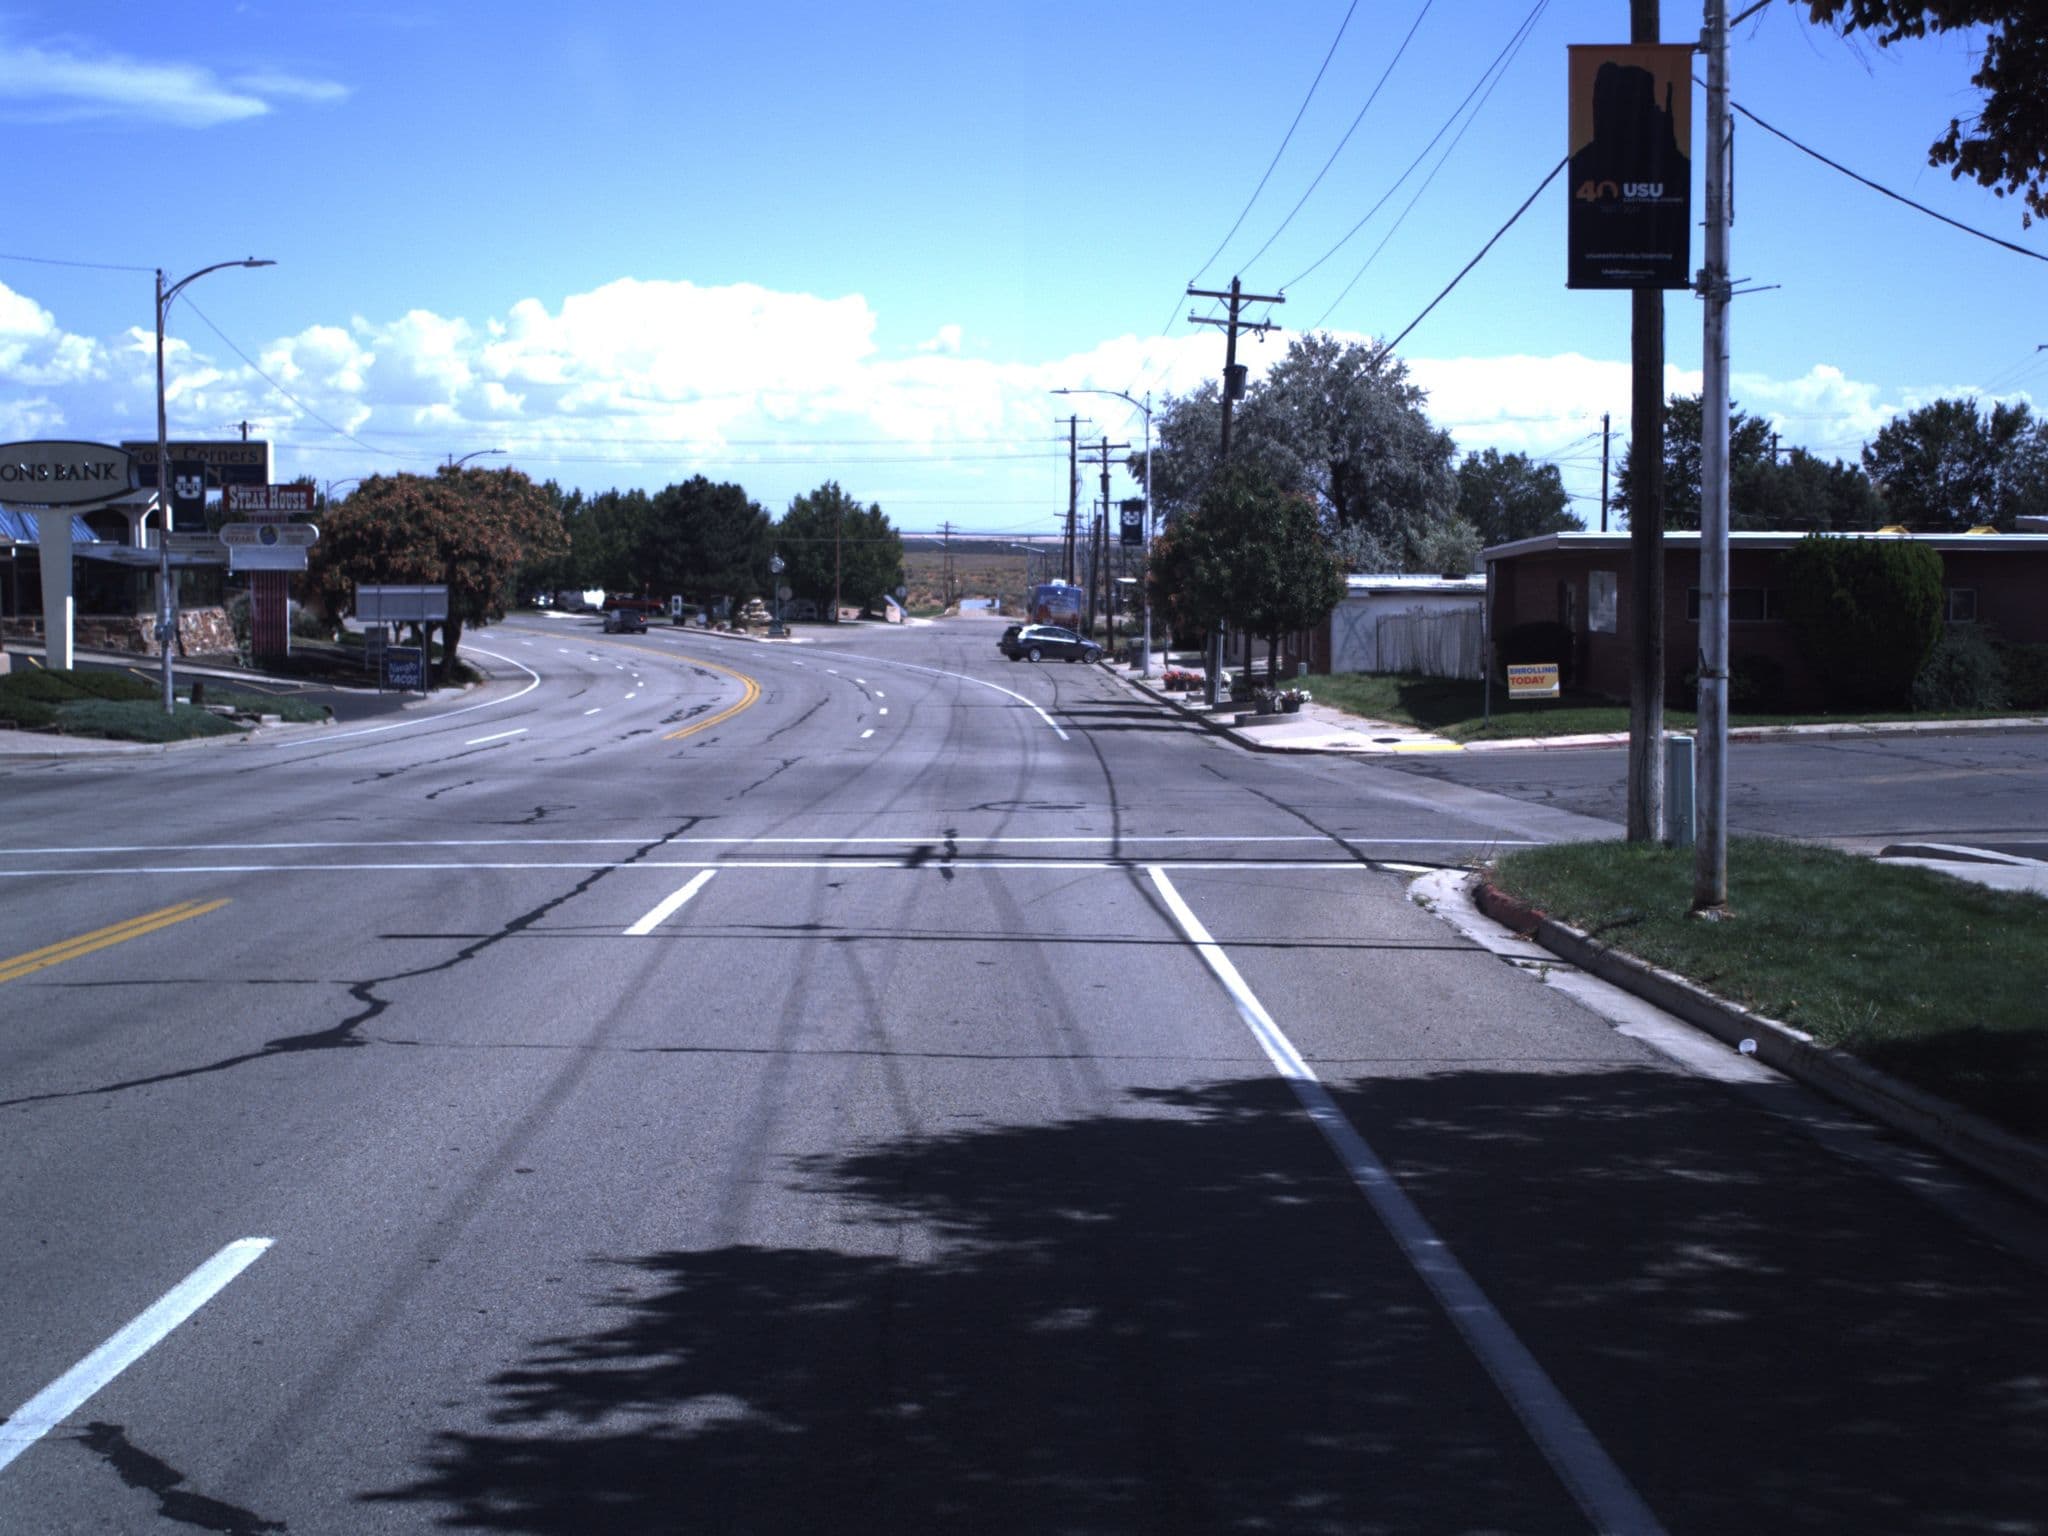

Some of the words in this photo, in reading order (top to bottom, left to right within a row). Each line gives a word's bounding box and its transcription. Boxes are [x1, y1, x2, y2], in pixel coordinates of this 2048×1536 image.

[1623, 182, 1664, 198] USU
[184, 447, 258, 464] Corners
[0, 463, 48, 482] ONS
[54, 462, 118, 481] BANK
[228, 485, 266, 511] STEAK
[268, 486, 307, 510] HOUSE
[1510, 666, 1557, 675] ENROLLING
[1510, 675, 1545, 685] TODAY
